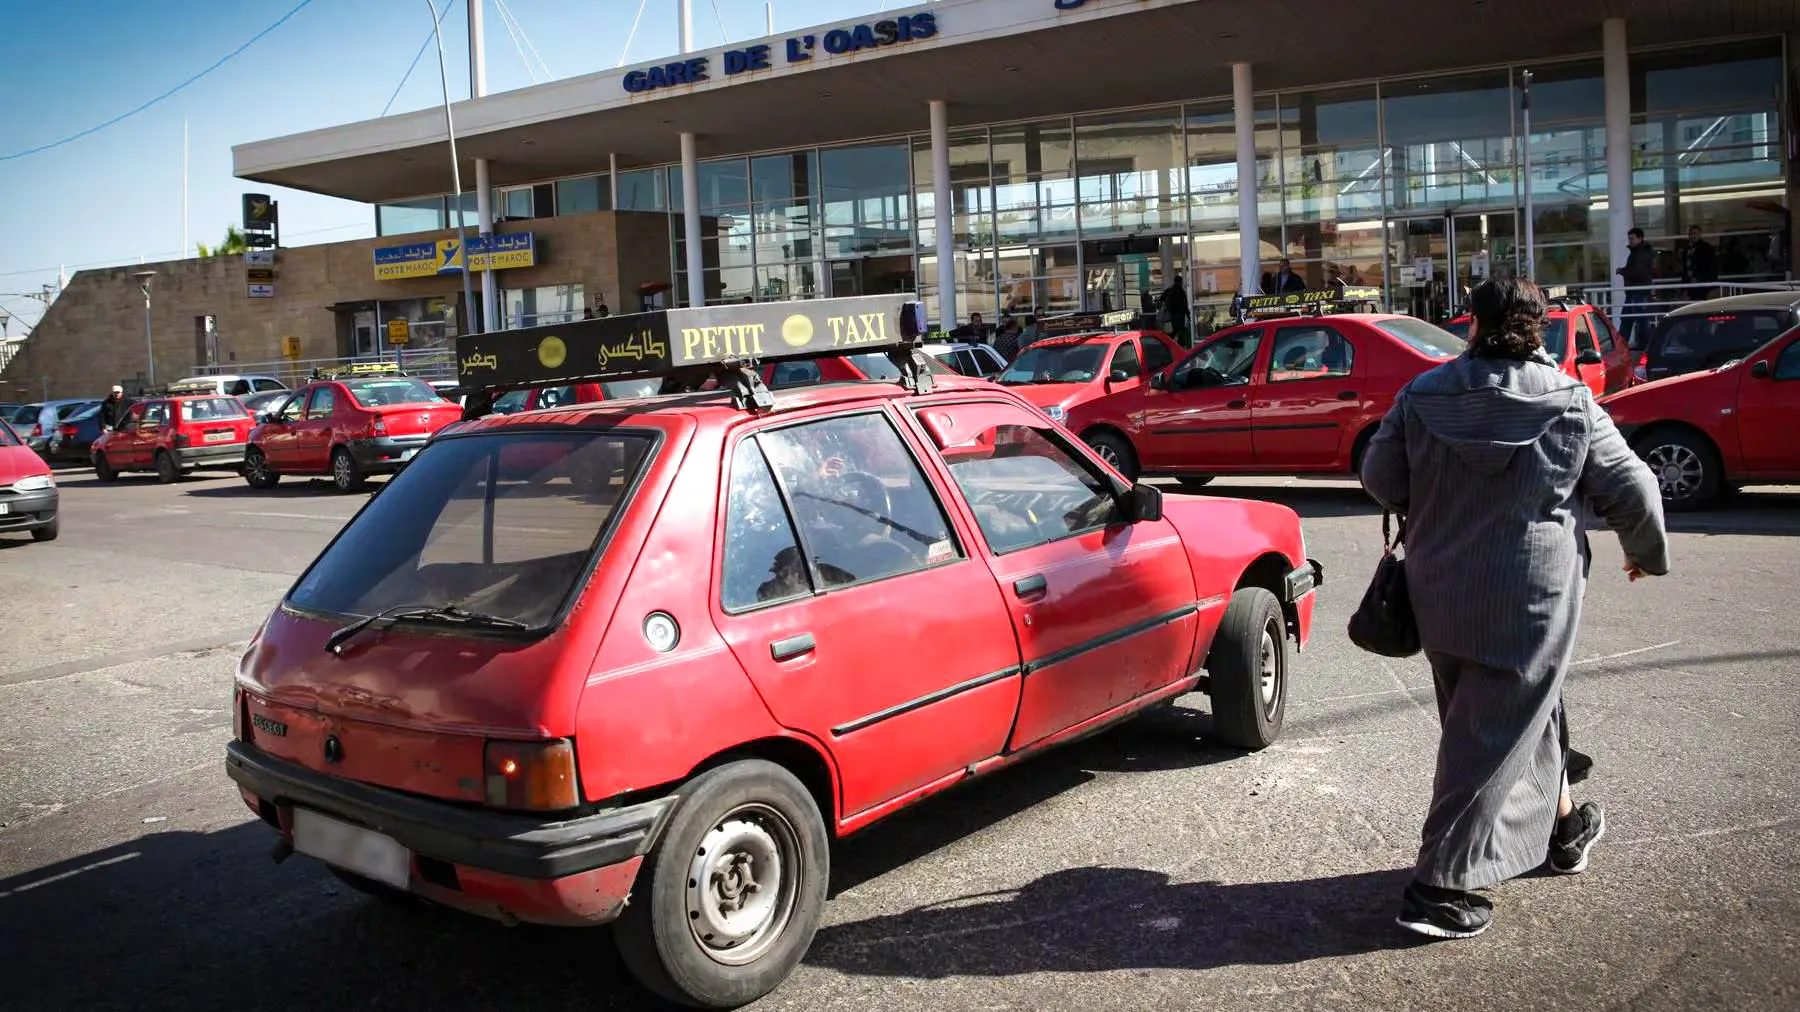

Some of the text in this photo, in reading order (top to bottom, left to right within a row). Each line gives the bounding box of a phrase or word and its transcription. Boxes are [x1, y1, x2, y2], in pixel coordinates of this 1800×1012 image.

[622, 12, 938, 93] GARE DE L' OASIS
[378, 261, 435, 275] POSTE MAROC
[498, 252, 529, 264] MAROC
[1249, 289, 1336, 308] PETIT TAXI
[460, 327, 666, 376] طاكسي صغير
[681, 312, 888, 360] PETIT TAXI
